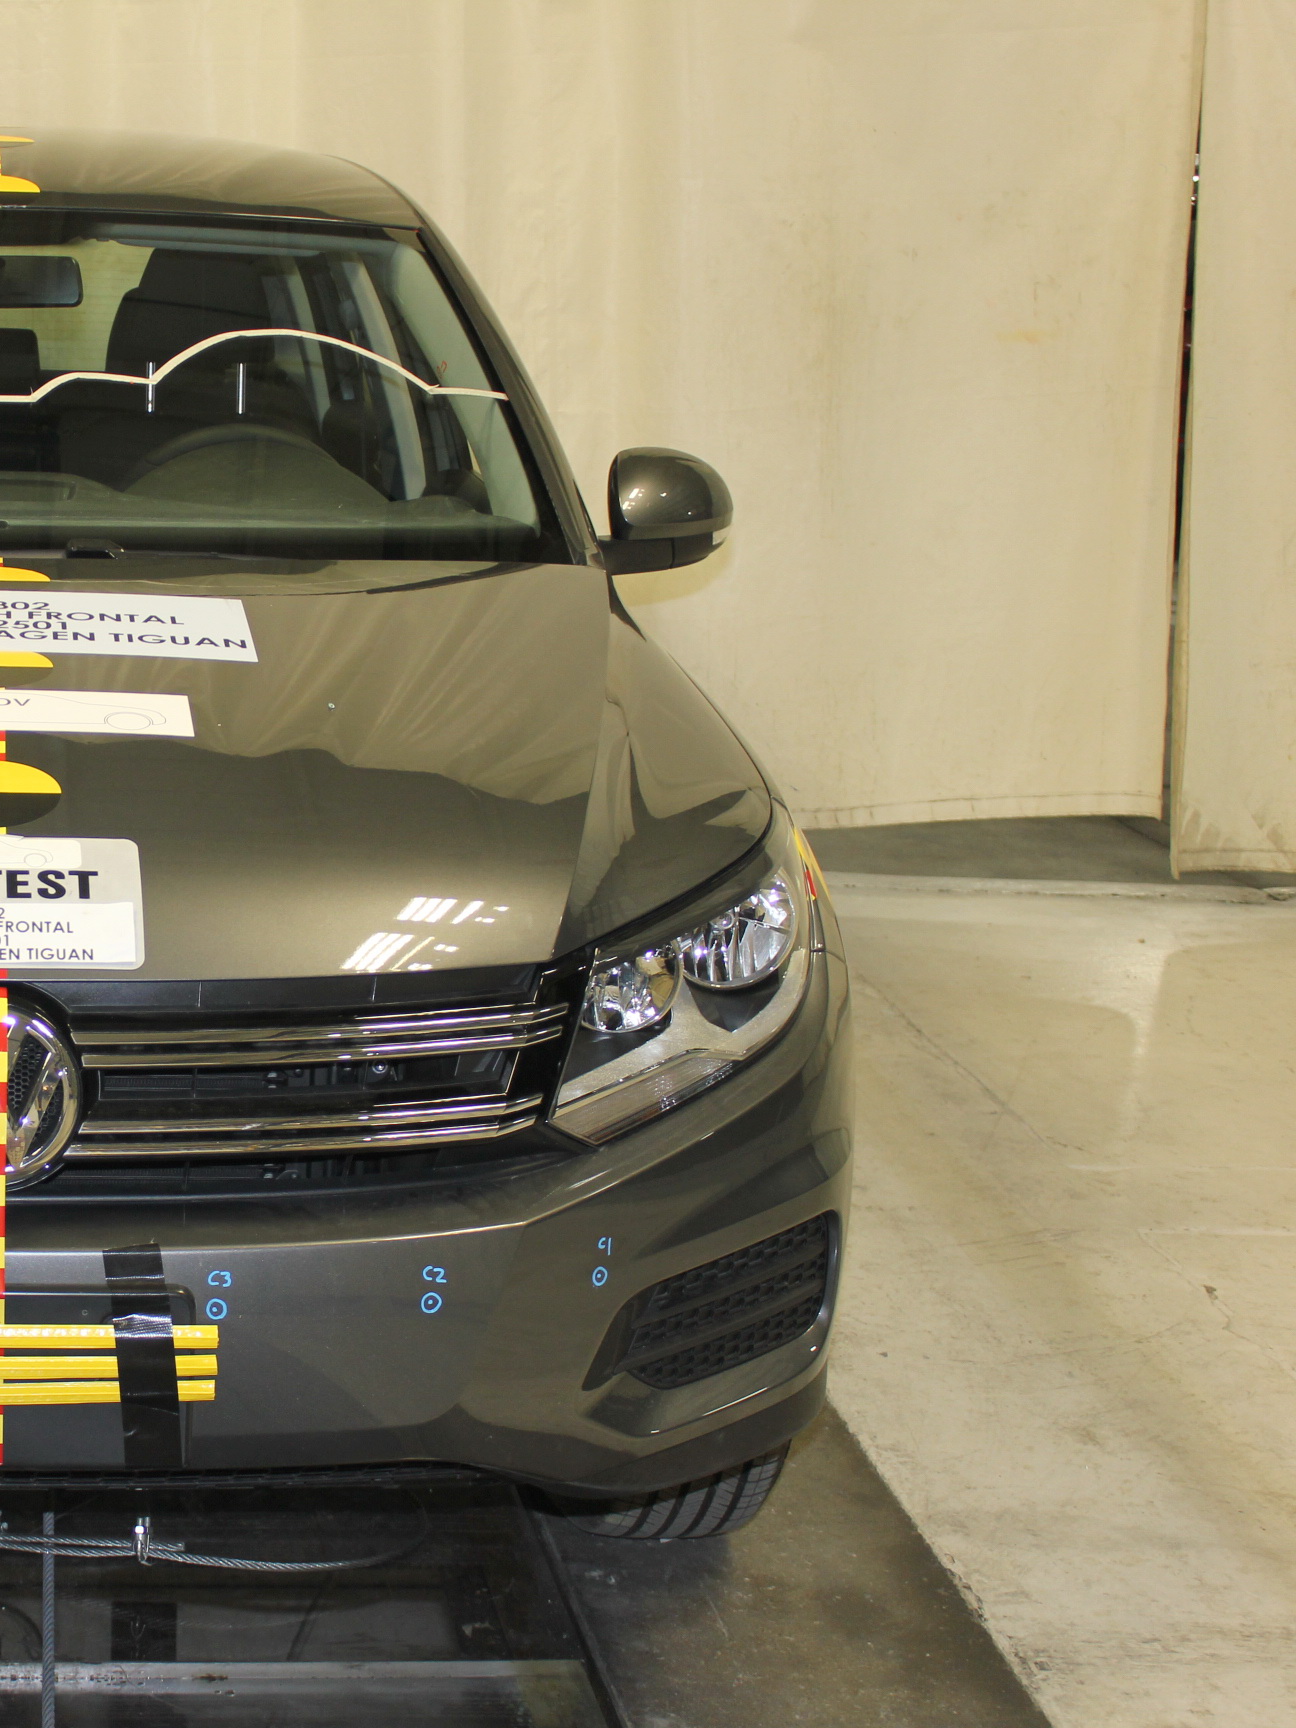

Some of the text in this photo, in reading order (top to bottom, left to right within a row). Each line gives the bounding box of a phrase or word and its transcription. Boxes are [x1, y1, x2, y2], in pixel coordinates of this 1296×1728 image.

[28, 611, 185, 626] FRONTAL
[109, 632, 248, 649] TIGUAN
[27, 948, 94, 961] TIGUAN
[206, 1269, 234, 1288] C3
[421, 1264, 448, 1284] C2
